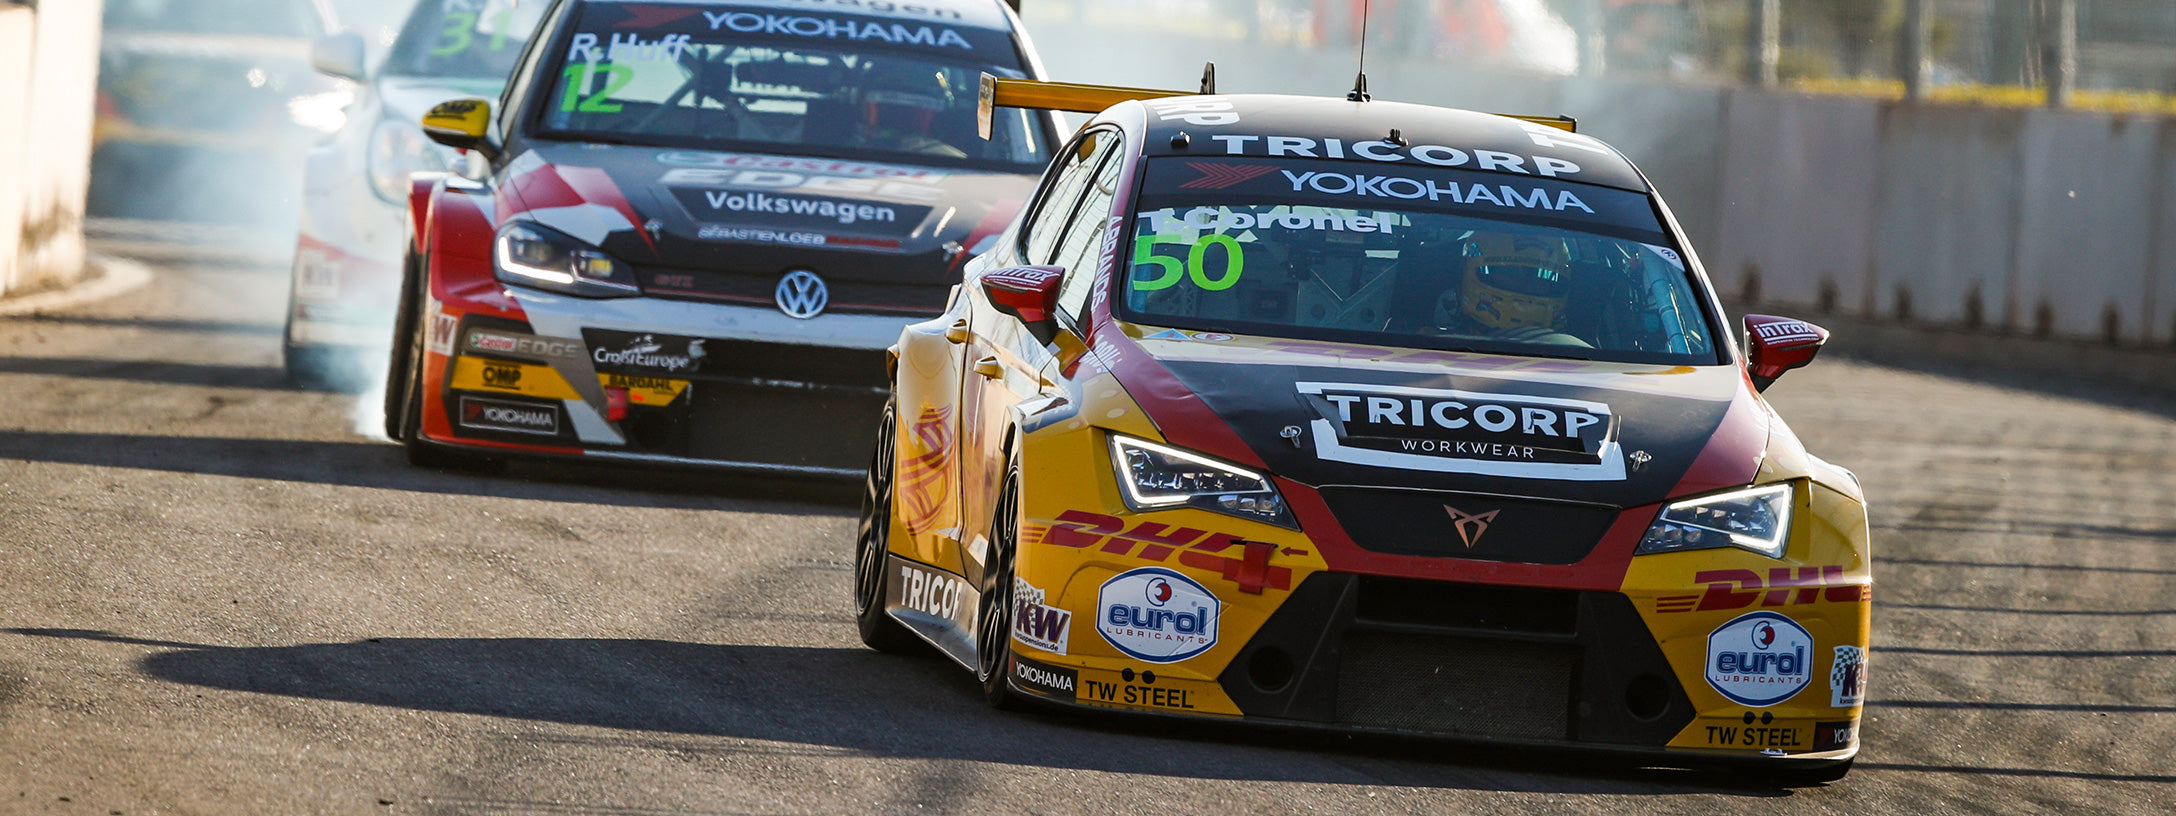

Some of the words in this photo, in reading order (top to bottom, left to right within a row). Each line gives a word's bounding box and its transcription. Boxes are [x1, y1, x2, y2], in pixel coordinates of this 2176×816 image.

[702, 10, 973, 50] YOKOHAMA
[568, 33, 691, 62] R.Huff
[561, 63, 633, 113] 12
[1212, 135, 1581, 177] TRICORP
[705, 191, 896, 223] Volkswagen
[1281, 169, 1596, 214] YOKOHAMA
[1138, 207, 1393, 234] T.Coronel
[1133, 233, 1244, 291] 50
[517, 338, 578, 359] EDGE
[482, 366, 522, 386] OMP
[482, 407, 553, 426] YOKOHAMA
[1327, 394, 1600, 438] TRICORP
[1401, 439, 1534, 460] WORKWEAR
[1694, 564, 1863, 612] DHL
[1016, 598, 1070, 644] KW
[1107, 603, 1208, 636] eurol
[1106, 626, 1206, 645] LUBRICANTS
[1716, 645, 1805, 676] eurol
[1015, 661, 1074, 692] YOKOHAMA
[1714, 674, 1803, 684] LUBRICANTS
[1085, 680, 1118, 702] TW
[1123, 684, 1195, 709] STEEL
[1705, 725, 1738, 745] TW
[1742, 727, 1801, 746] STEEL
